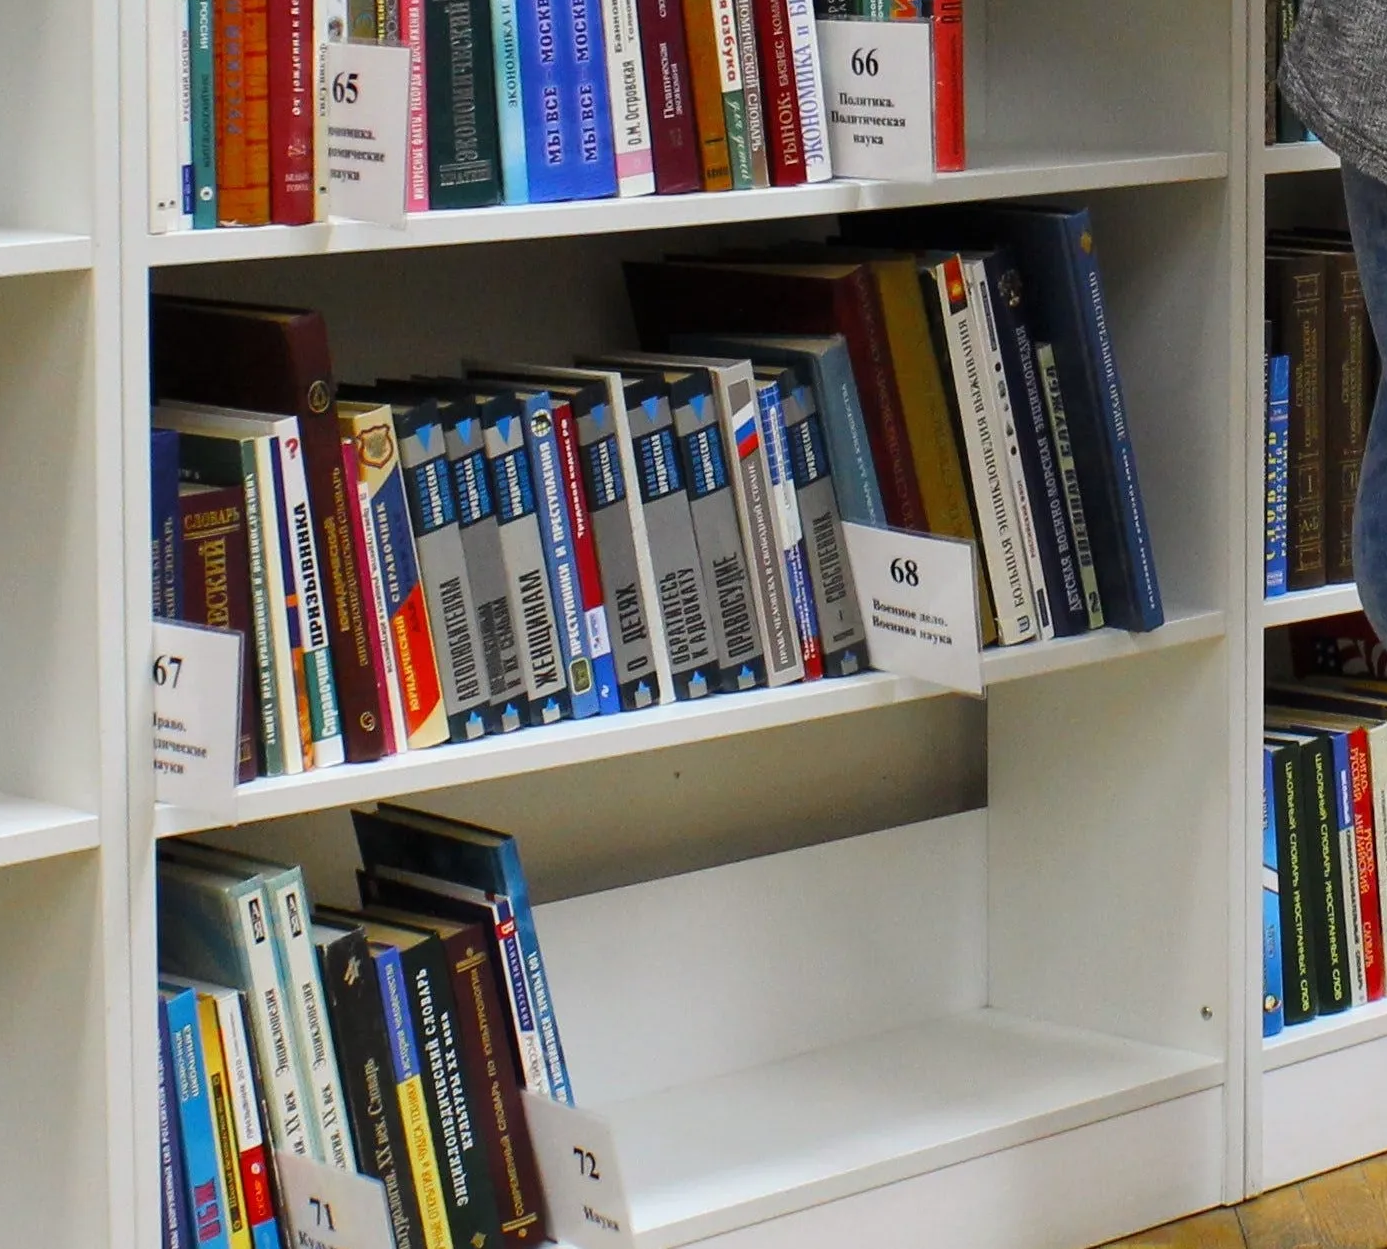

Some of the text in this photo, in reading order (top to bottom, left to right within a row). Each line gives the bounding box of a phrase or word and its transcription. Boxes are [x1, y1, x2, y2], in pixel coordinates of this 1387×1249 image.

[849, 46, 880, 79] 66
[332, 70, 359, 107] 65
[540, 86, 560, 122] ВСЕ
[793, 42, 823, 167] ЭКОНОМИКА
[838, 91, 896, 111] Политика.
[328, 127, 376, 143] номика.
[829, 110, 908, 132] Политическая
[327, 145, 386, 165] омические
[543, 128, 563, 164] МЫ
[852, 129, 884, 149] наука
[329, 166, 360, 184] науки
[537, 441, 581, 656] ПРЕСТУПНИКИ И ПРЕСТУПЛЕНИЯ
[294, 502, 325, 647] ПРИЗЫВНИКА
[890, 557, 920, 588] 68
[872, 597, 915, 621] Военное
[439, 576, 479, 703] АВТОЛЮБИТЕЛЯМ
[518, 570, 559, 689] ЖЕНЩИНАМ
[872, 615, 952, 646] Военная наука
[152, 657, 183, 689] 67
[150, 714, 187, 734] раво.
[1285, 761, 1298, 830] ШКОЛЬНЫЙ
[1290, 832, 1302, 887] СЛОВАРЬ
[1293, 889, 1308, 975] ИНОСТРАННЫХ
[414, 968, 471, 1206] ЭНЦИКЛОПЕДИЧЕСКИЙ СЛОВАРЬ
[571, 1146, 601, 1181] 72
[310, 1196, 336, 1232] 71
[583, 1202, 621, 1234] Наука
